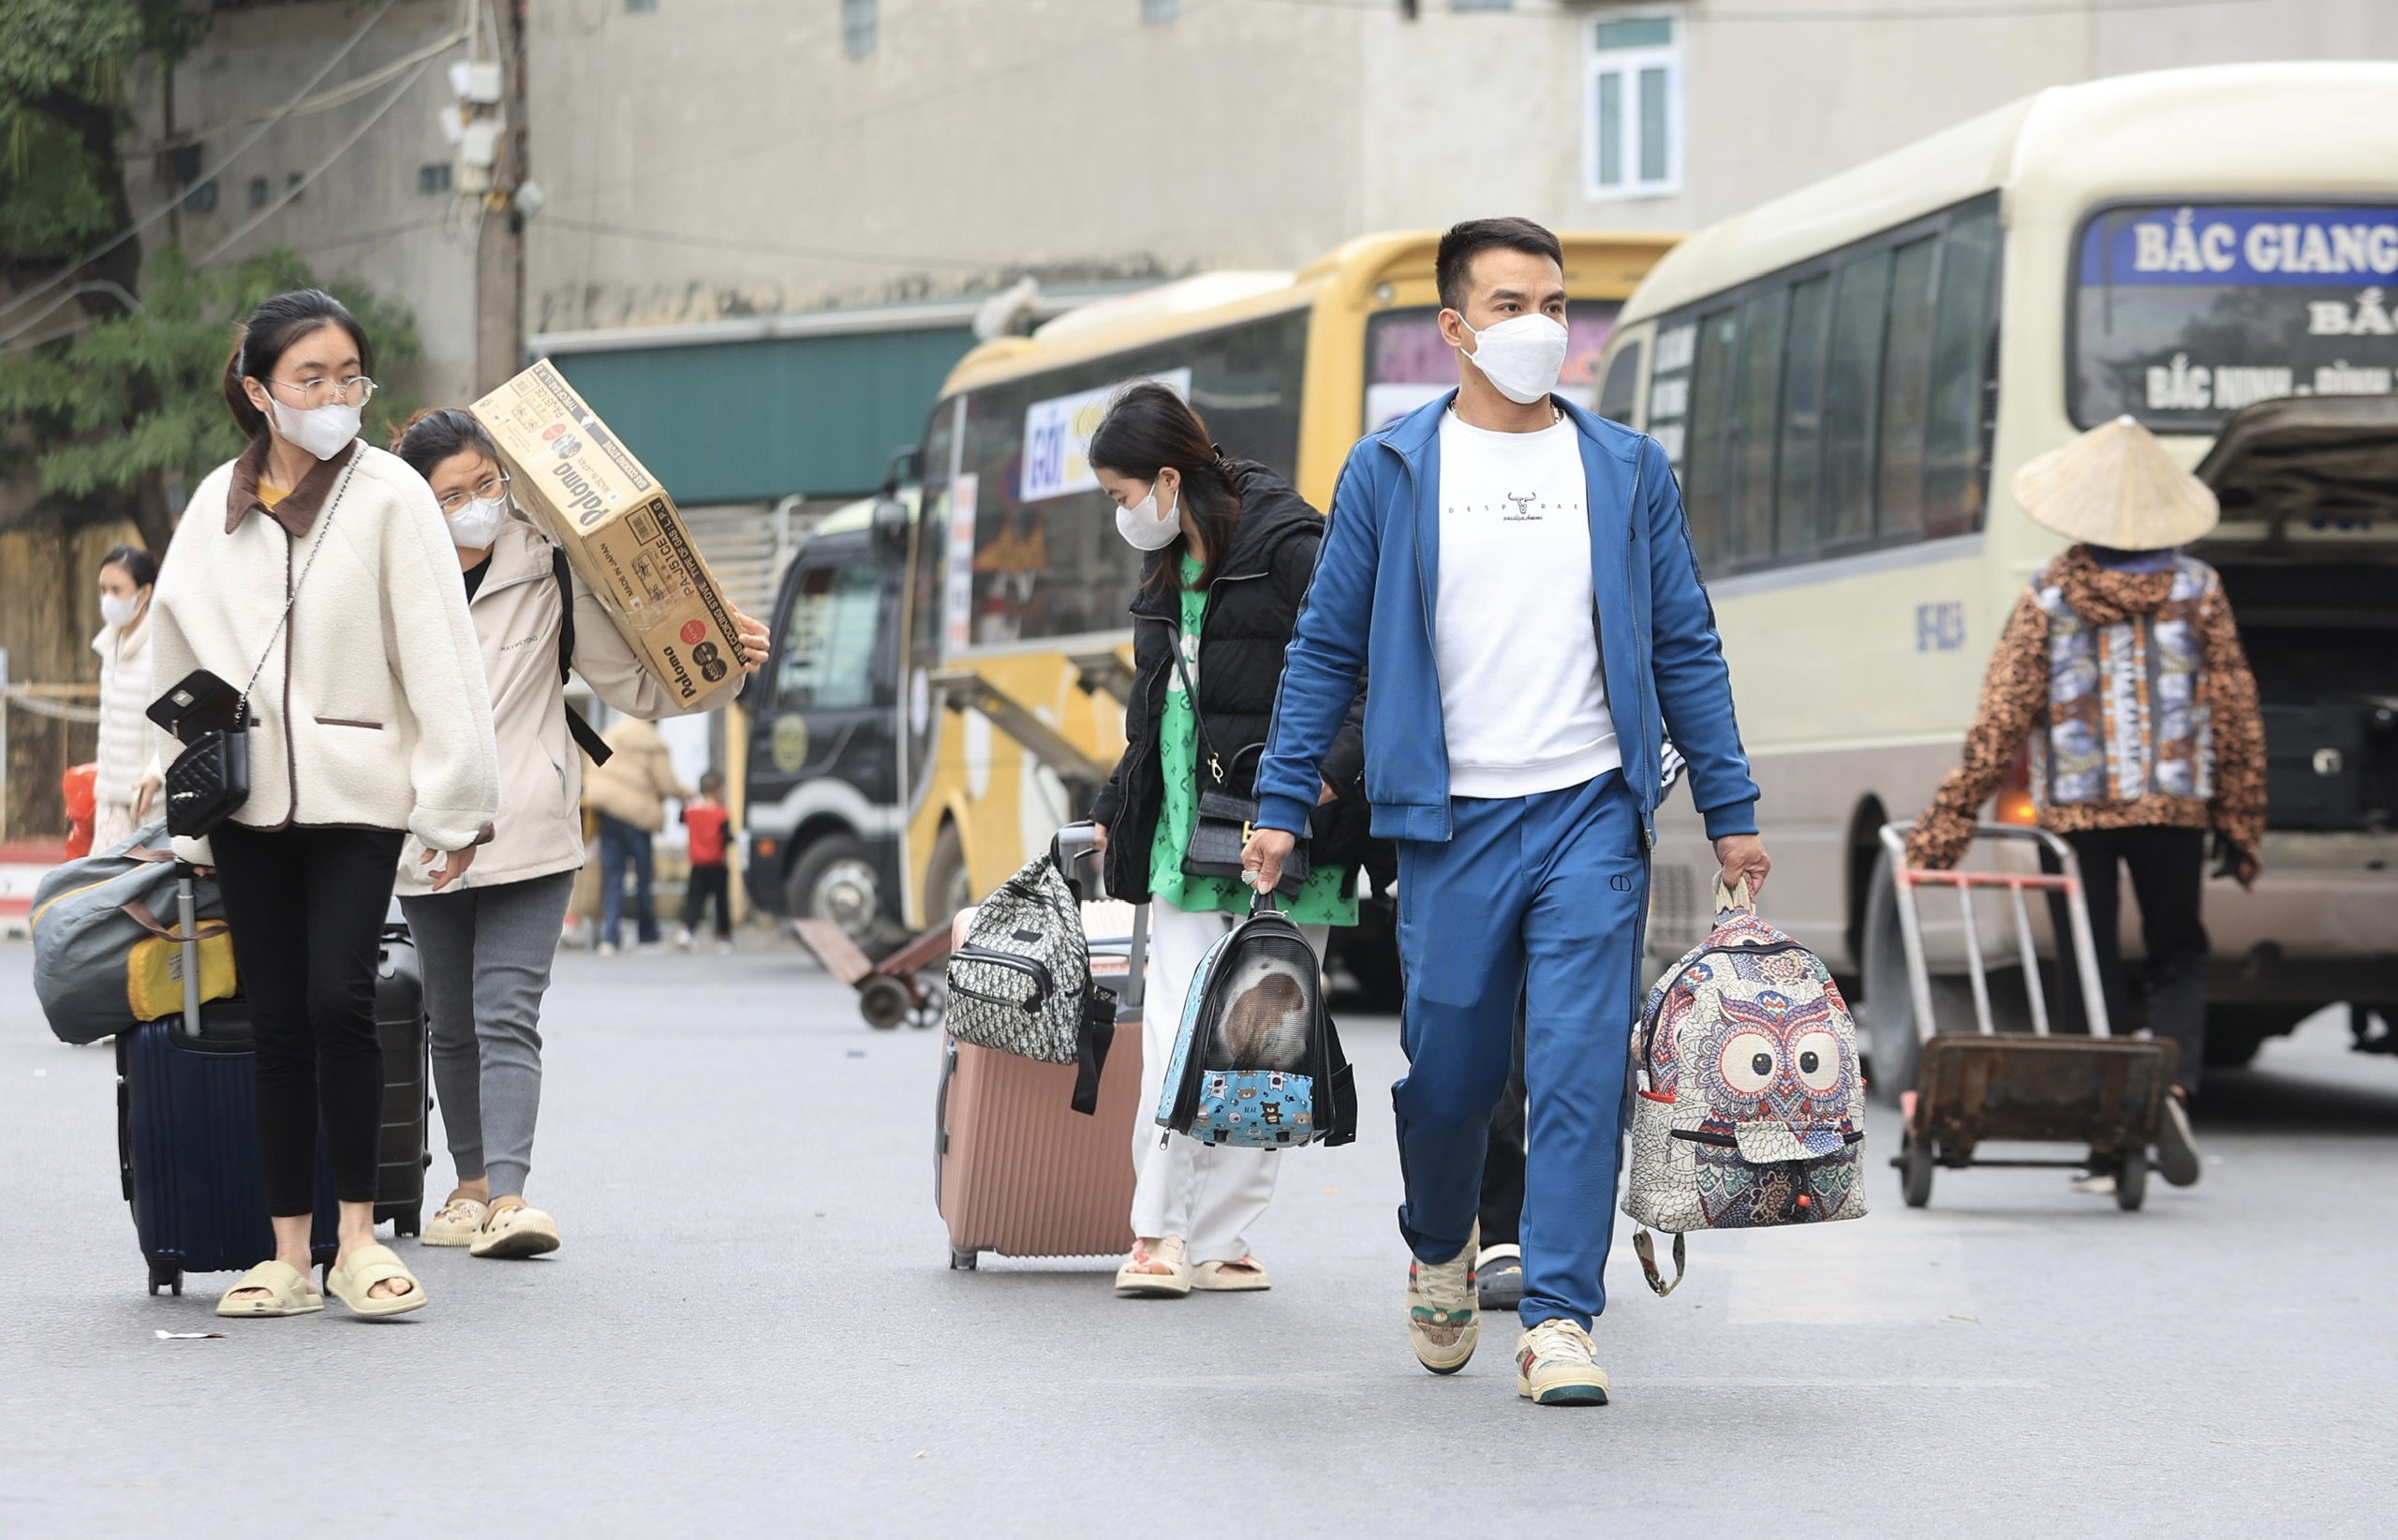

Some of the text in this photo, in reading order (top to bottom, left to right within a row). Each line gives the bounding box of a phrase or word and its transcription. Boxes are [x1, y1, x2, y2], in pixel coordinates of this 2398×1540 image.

[2134, 206, 2398, 273] BẮC GIANG
[2306, 286, 2398, 335] BẮ
[2146, 351, 2212, 409] BẮC
[576, 457, 595, 475] JAPAN
[594, 478, 611, 494] MADE
[553, 462, 611, 526] Paloma
[669, 529, 683, 547] GAS
[677, 546, 688, 558] OF
[600, 542, 634, 597] MADE IN JAPAN
[656, 537, 694, 597] PA-J51CE
[684, 556, 700, 577] TYPE
[698, 582, 718, 610] STOVE
[713, 608, 738, 644] COOKING
[663, 645, 698, 700] Paloma
